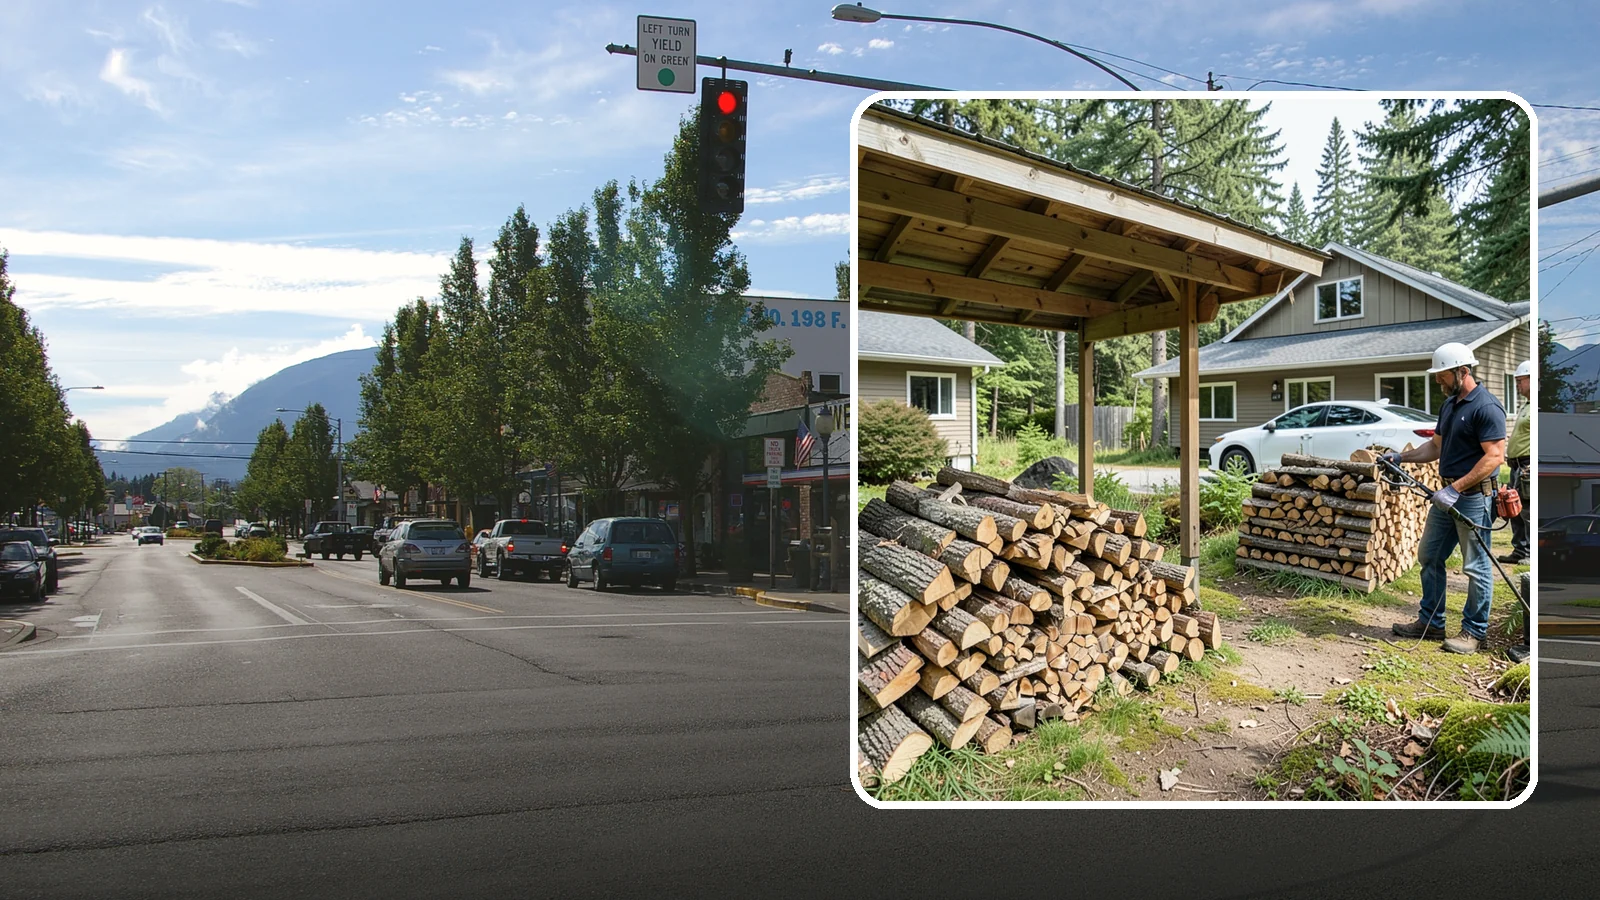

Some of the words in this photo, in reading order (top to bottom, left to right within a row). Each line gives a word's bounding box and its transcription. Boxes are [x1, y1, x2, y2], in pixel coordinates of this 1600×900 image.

[643, 23, 663, 34] LEFT
[668, 25, 690, 37] TURN
[652, 38, 682, 52] YIELD
[644, 53, 656, 64] ON
[661, 54, 689, 66] GREEN
[791, 309, 826, 328] 198
[831, 311, 847, 329] F.
